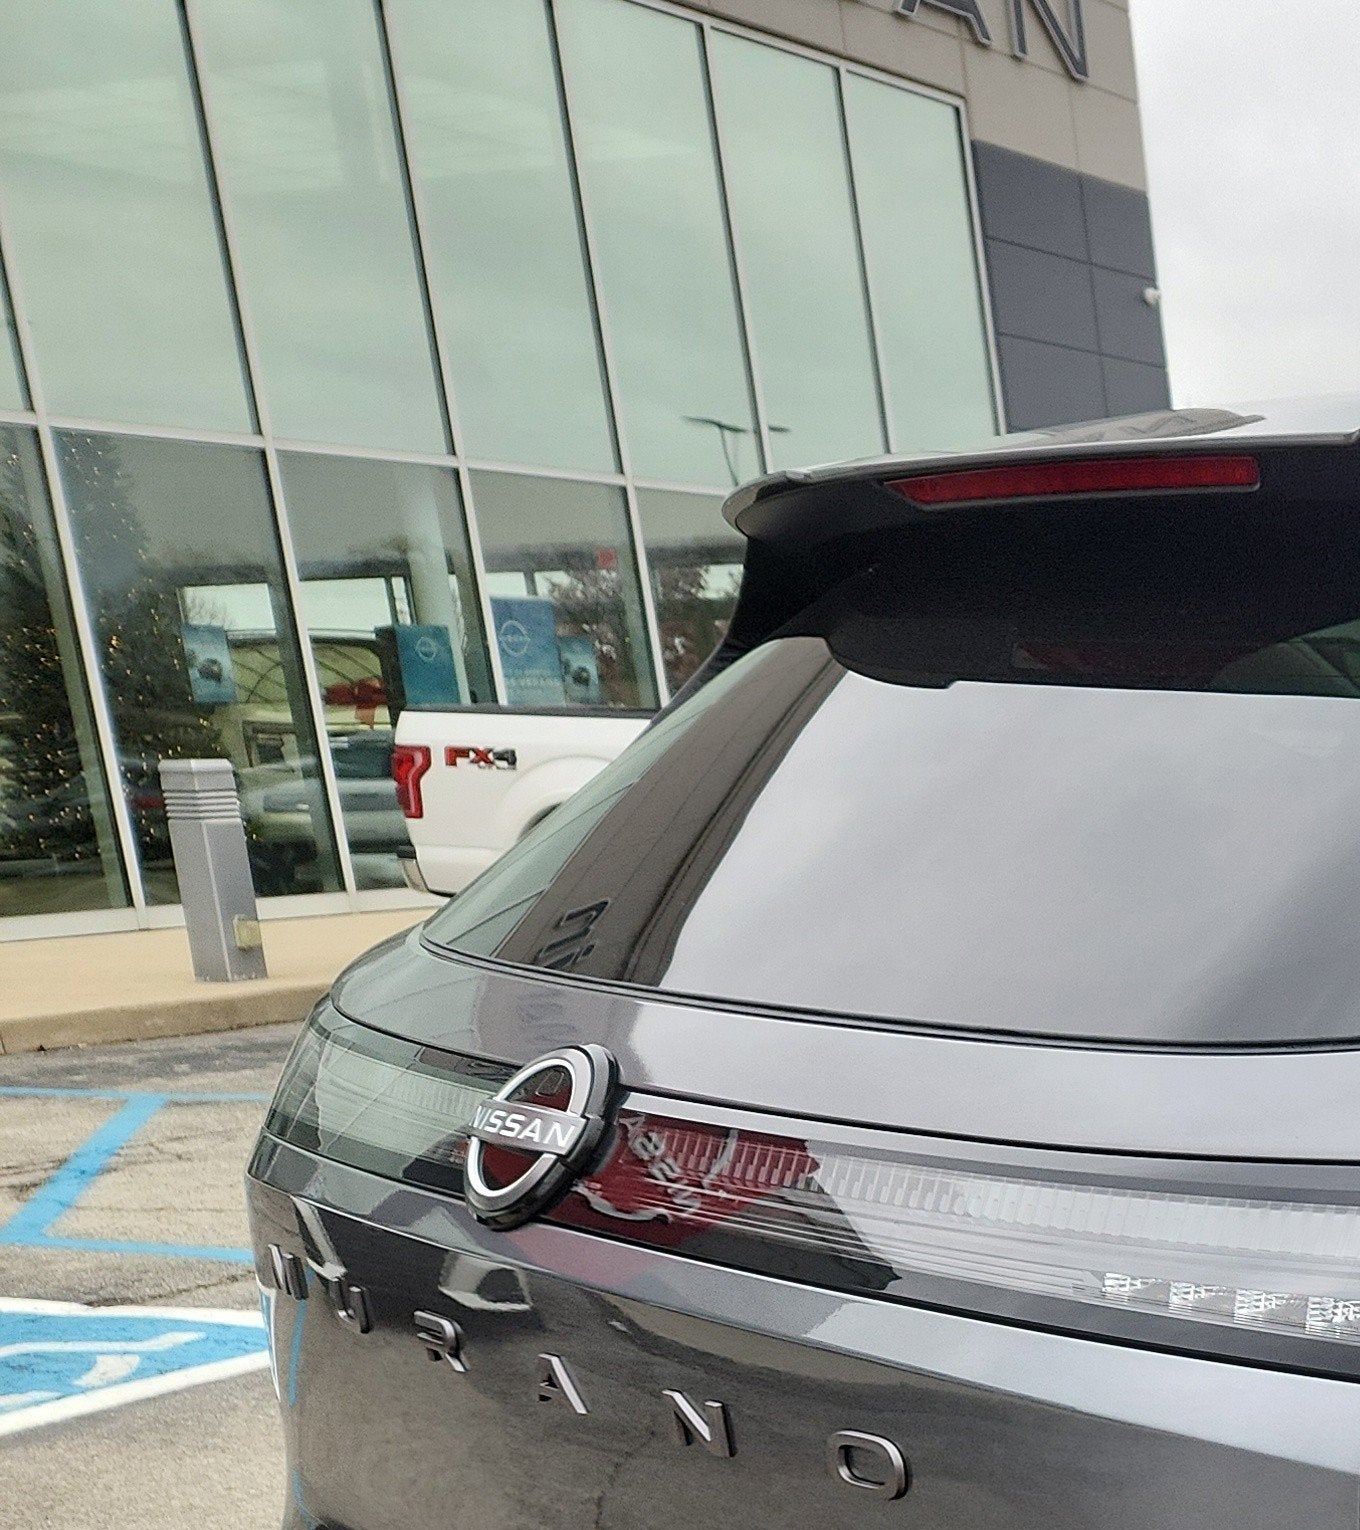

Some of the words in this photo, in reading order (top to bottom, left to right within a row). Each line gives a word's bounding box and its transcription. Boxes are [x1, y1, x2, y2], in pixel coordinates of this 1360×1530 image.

[444, 746, 517, 770] FX4
[469, 1105, 576, 1147] NISSAN
[266, 1243, 910, 1502] MURANO
